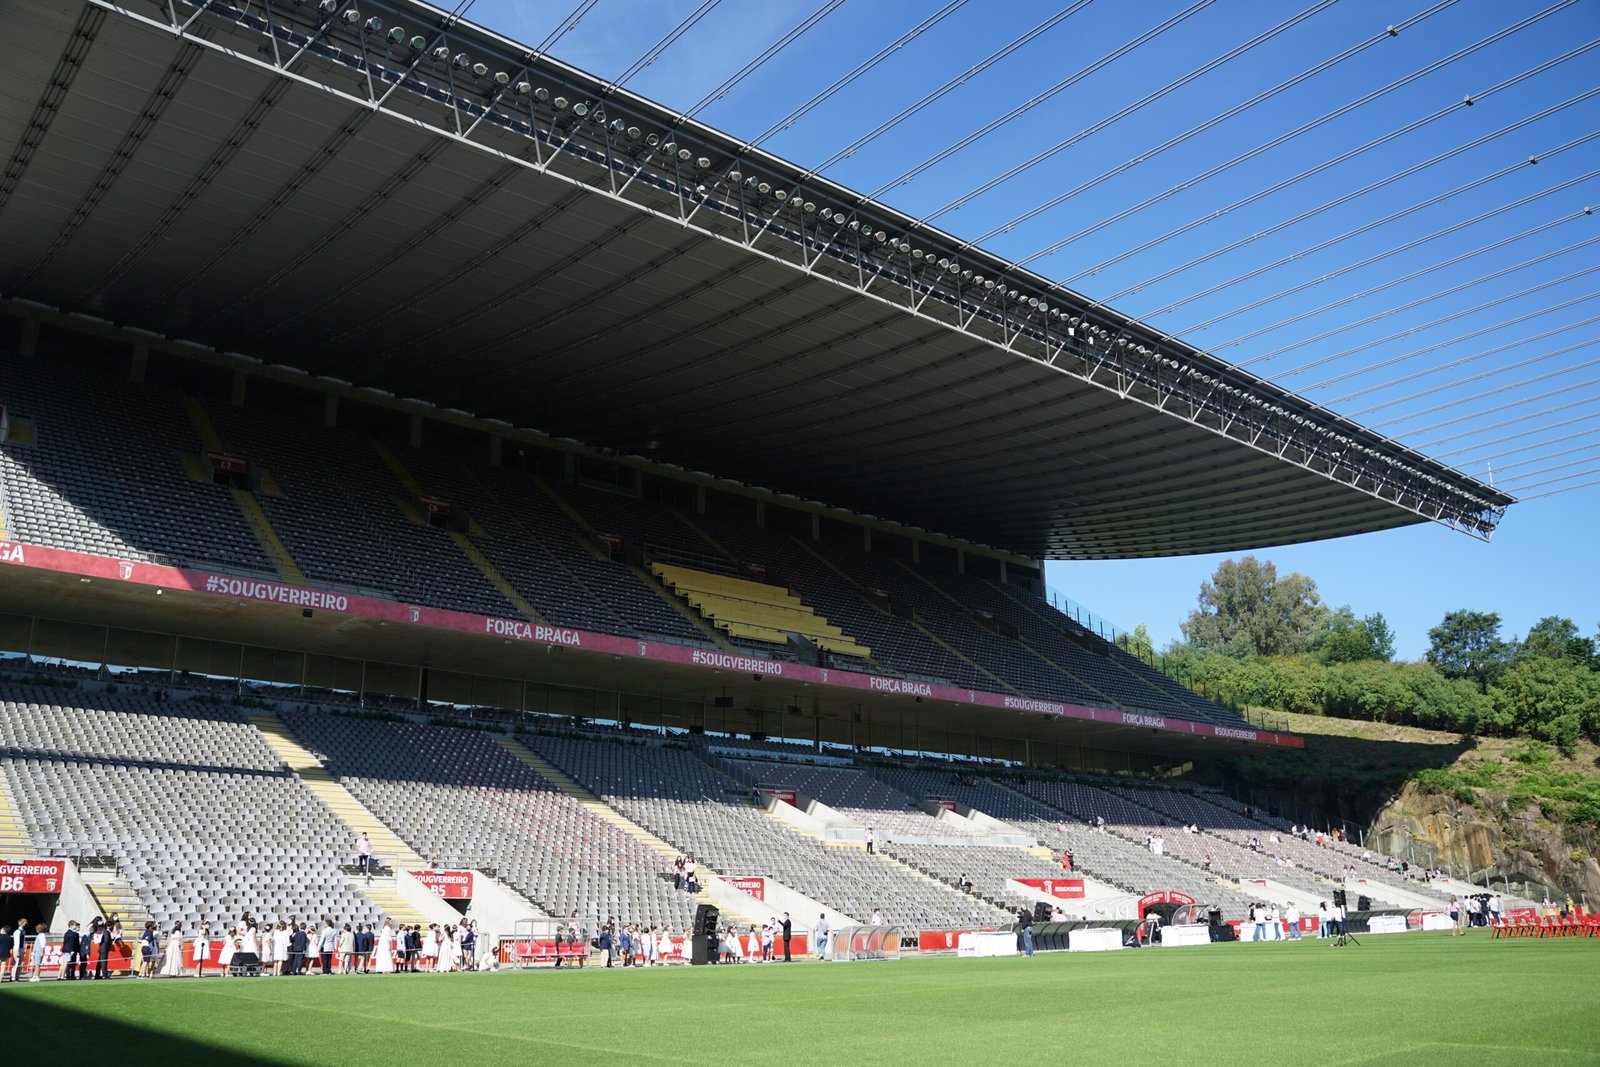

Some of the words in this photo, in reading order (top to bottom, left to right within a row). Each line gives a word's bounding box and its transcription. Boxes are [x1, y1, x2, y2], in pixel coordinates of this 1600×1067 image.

[206, 575, 348, 611] #SOUGVERREIRO
[486, 618, 532, 640] FORÇA
[535, 625, 580, 646] BRAGA
[692, 650, 782, 675] #SOUGVERREIRO
[870, 676, 900, 693] FORÇA
[902, 681, 932, 696] BRAGA
[1004, 696, 1064, 715] #SOUGVERREIRO
[1122, 712, 1144, 726] FORÇA
[1144, 716, 1166, 728] BRAGA
[0, 876, 24, 891] B6
[430, 884, 446, 897] B5
